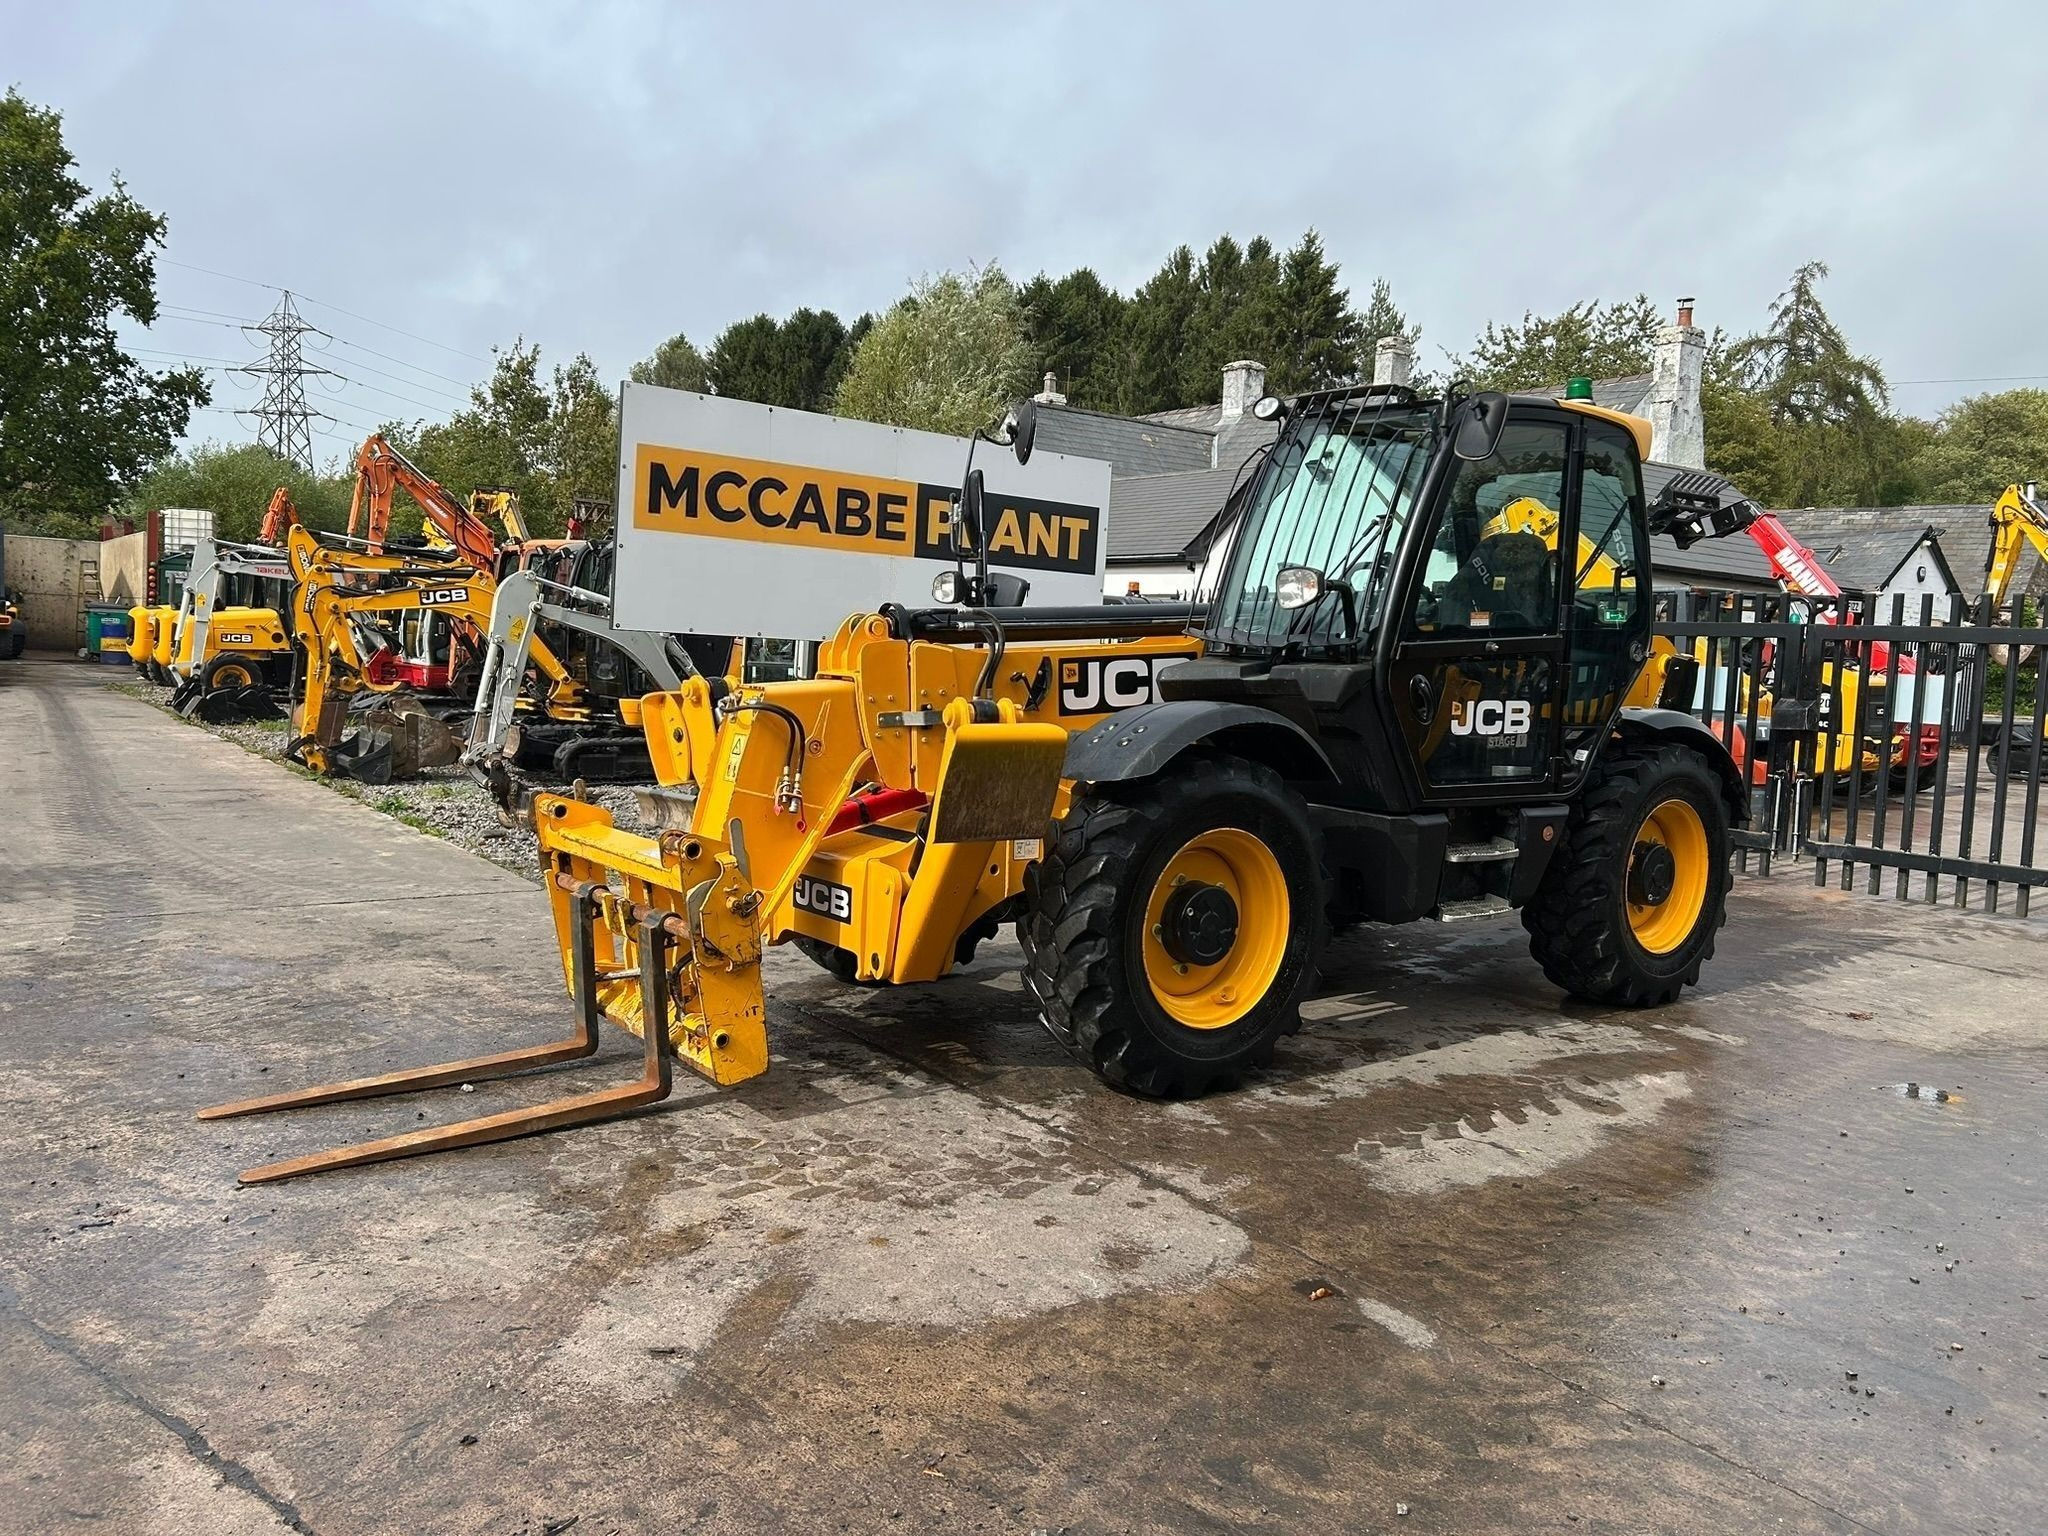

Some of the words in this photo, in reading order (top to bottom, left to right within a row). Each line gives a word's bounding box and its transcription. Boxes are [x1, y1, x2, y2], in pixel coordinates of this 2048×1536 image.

[647, 461, 908, 541] MCCABE
[927, 498, 1090, 561] PANT
[254, 565, 290, 576] TAKEU
[421, 589, 467, 604] JCB
[222, 634, 252, 643] JCB
[1451, 700, 1531, 736] JCB
[1488, 736, 1516, 747] STAGE
[796, 880, 849, 918] JCB
